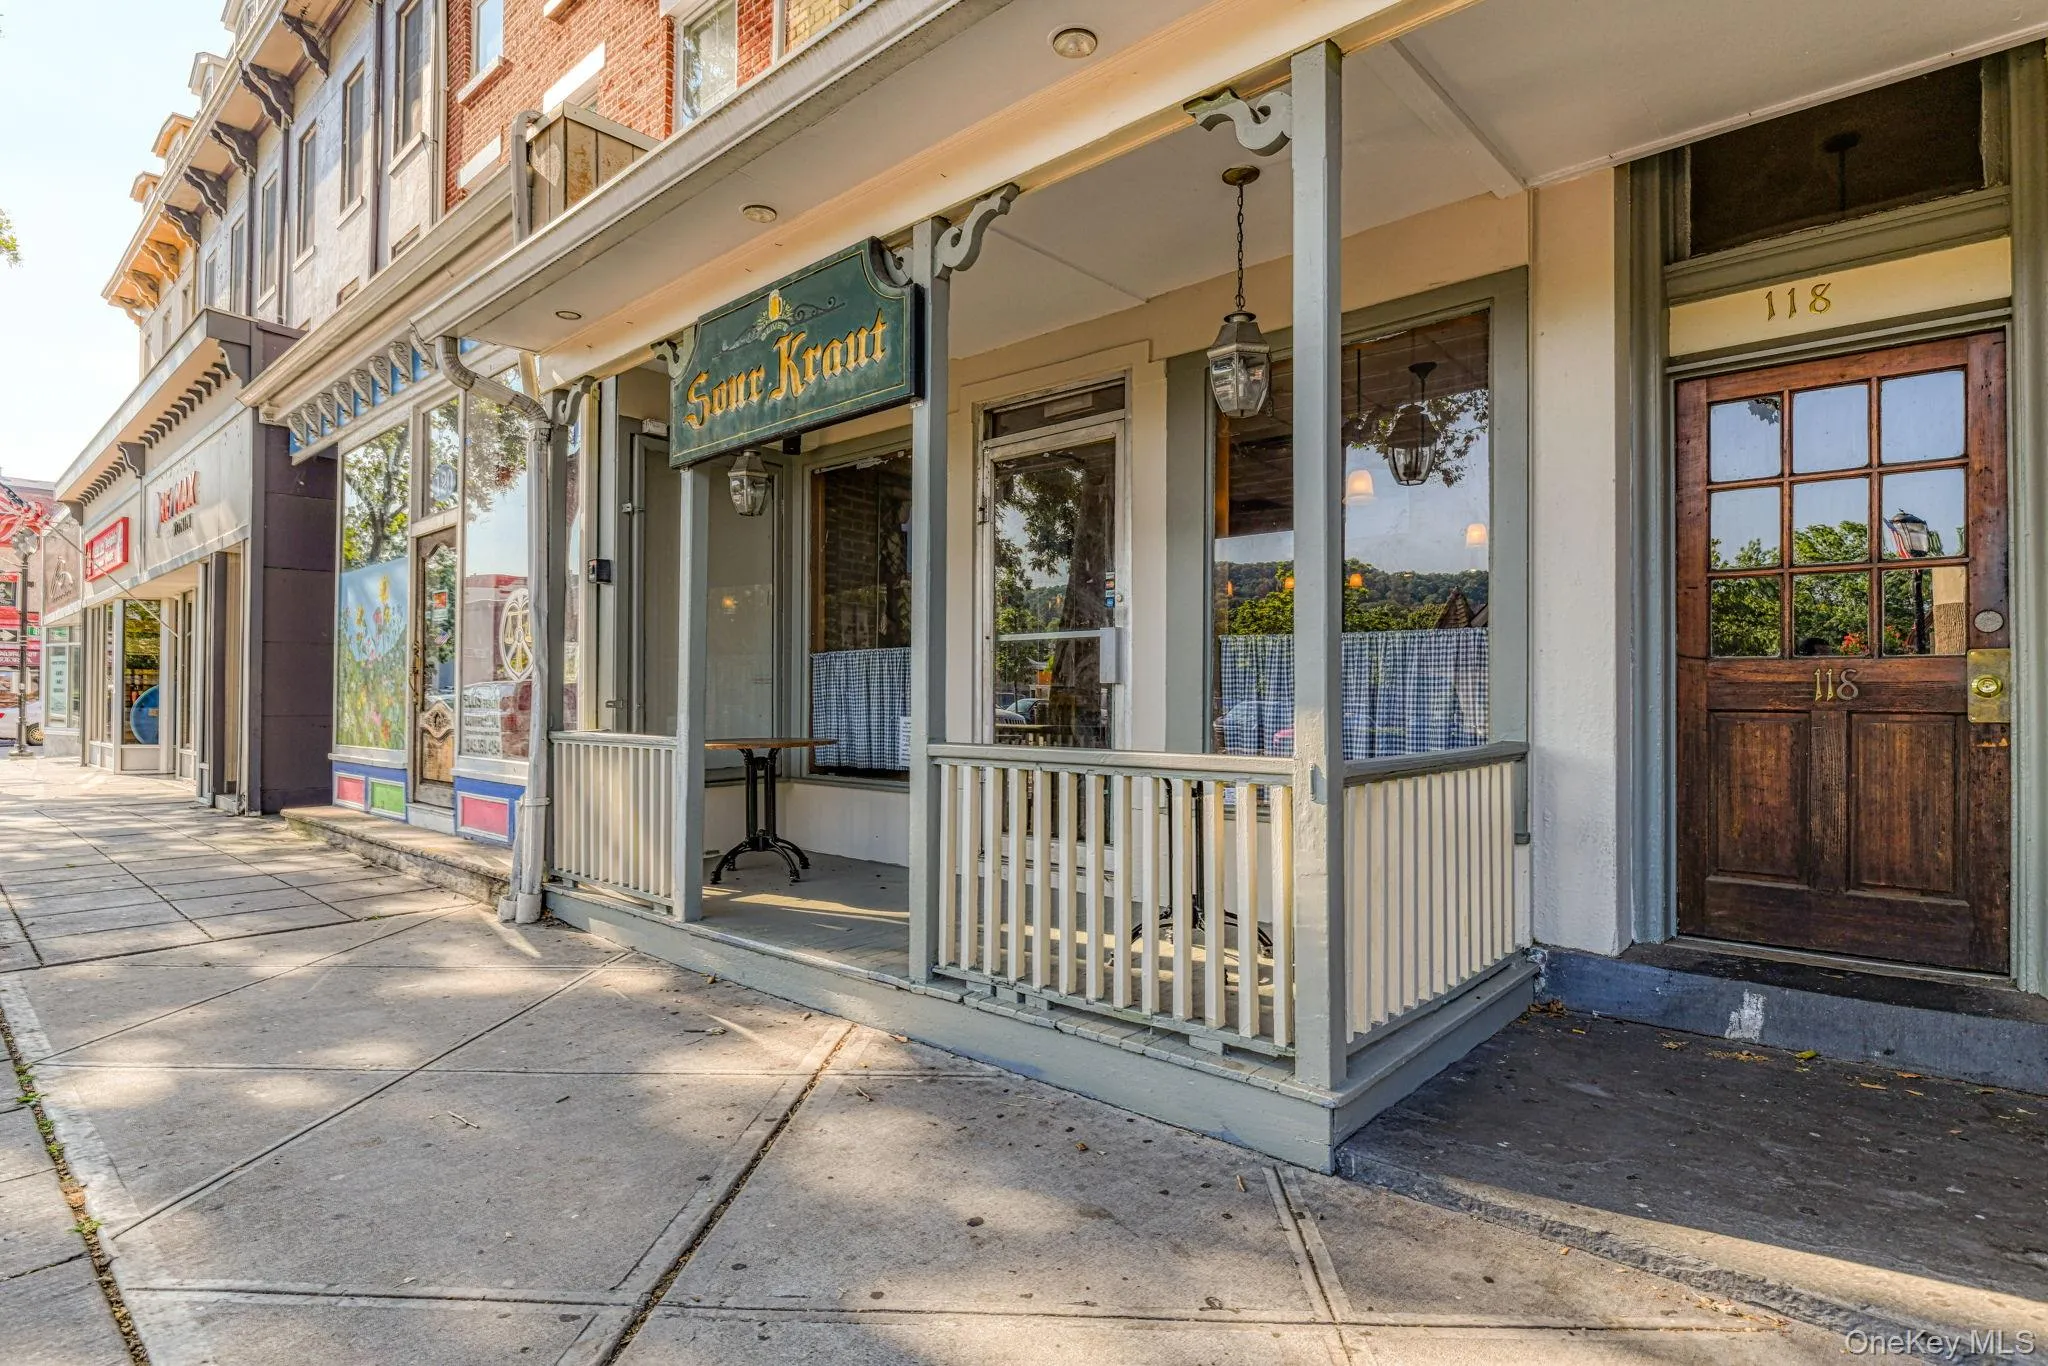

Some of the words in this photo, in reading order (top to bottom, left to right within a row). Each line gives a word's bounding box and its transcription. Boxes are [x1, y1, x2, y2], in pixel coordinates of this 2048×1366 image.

[1764, 282, 1831, 321] 118
[683, 365, 766, 430] Sour
[769, 308, 888, 400] Kraut
[1814, 668, 1859, 702] 118
